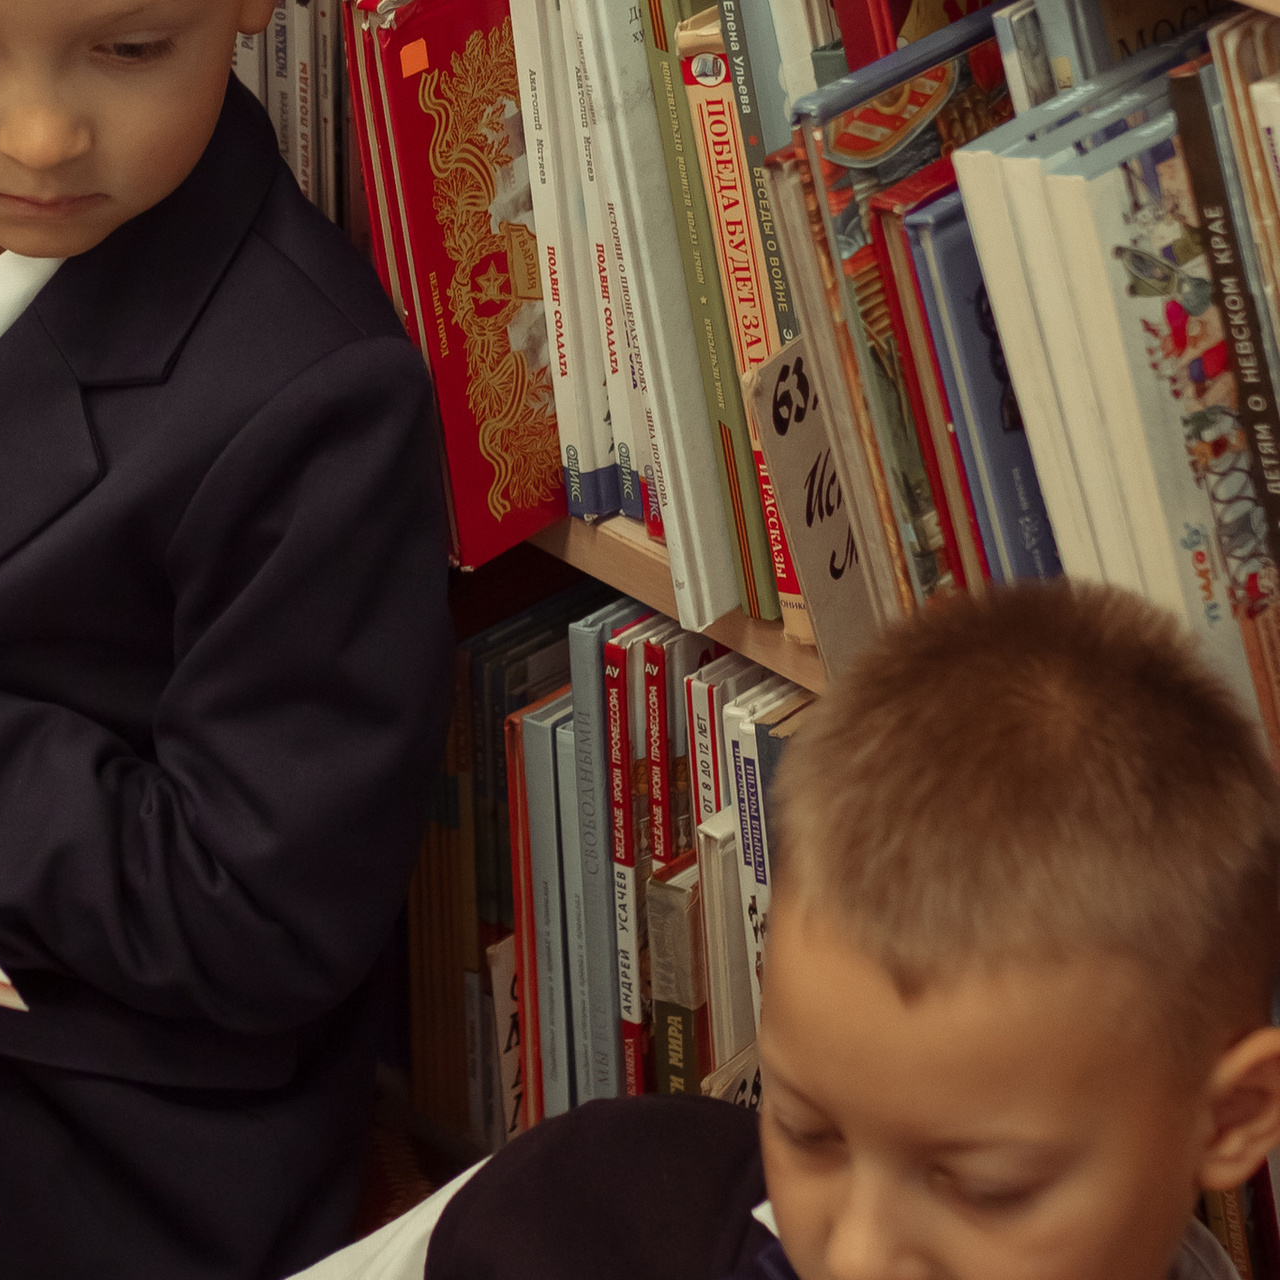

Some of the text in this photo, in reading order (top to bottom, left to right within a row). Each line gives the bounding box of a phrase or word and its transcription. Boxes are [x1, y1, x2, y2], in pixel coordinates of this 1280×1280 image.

[274, 24, 287, 79] РАССКАЗЫ
[299, 62, 309, 128] ПОБЕДЫ
[528, 68, 547, 185] Анатолий Митяев
[574, 66, 596, 182] Анатолий Митяев
[660, 60, 684, 153] ОТЕЧЕСТВЕННОЙ
[675, 154, 693, 206] ВЕЛИКОЙ
[722, 0, 789, 313] Елена Ульева БЕСЕДЫ О ВОЙНЕ
[692, 247, 705, 285] ЮНЫЕ
[706, 98, 763, 351] ПОБЕДА БУДЕТ ЗА
[428, 271, 450, 359] БЕЛЫЙ ГОРОД
[546, 245, 568, 378] ПОДВИГ СОЛДАТА
[596, 243, 619, 375] ПОДВИГ СОЛДАТА
[1222, 277, 1262, 386] НЕВСКОМ
[607, 202, 623, 262] ИСТОРИИ
[620, 275, 649, 395] ПИОНЕРАХ-ГЕРОЯХ.
[644, 408, 656, 439] ЗИНА
[651, 442, 668, 508] ПОРТНОВА
[565, 444, 582, 503] ОНИКС
[617, 441, 634, 502] ОНИКС
[762, 484, 787, 579] РАССКАЗЫ
[607, 687, 622, 765] ПРОФЕССОРА
[648, 685, 661, 763] ПРОФЕССОРА
[695, 713, 713, 814] ОТ 8 ДО 12 ЛЕТ
[576, 710, 600, 876] СВОБОДНЫМИ
[609, 765, 623, 804] УРОКИ
[650, 765, 663, 802] УРОКИ
[746, 764, 766, 881] ИСТОРИЯ РОССИИ
[619, 948, 633, 1016] АНДРЕЙ
[667, 1015, 684, 1069] МИРА
